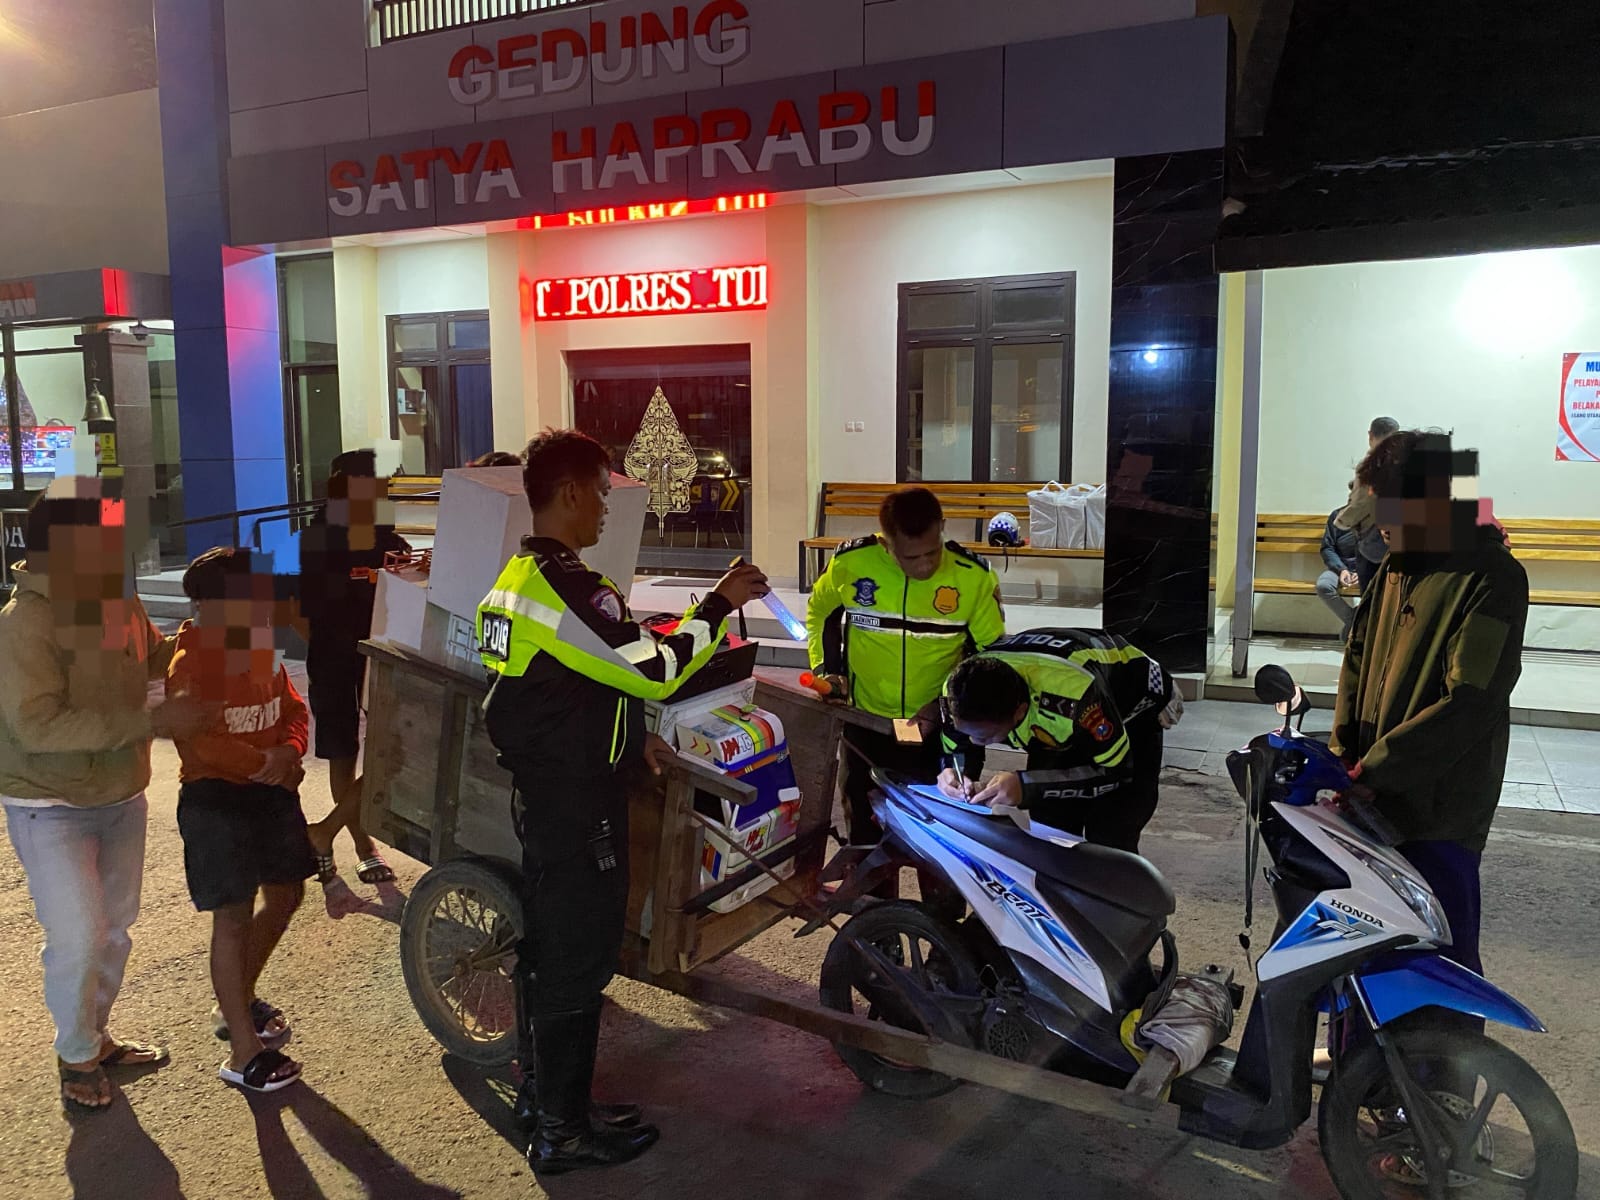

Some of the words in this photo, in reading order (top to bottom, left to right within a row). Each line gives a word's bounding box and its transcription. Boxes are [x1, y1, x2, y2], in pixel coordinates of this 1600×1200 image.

[448, 0, 750, 104] GEDUNG
[328, 138, 521, 217] SATYA
[552, 80, 937, 193] HAPRABU
[568, 270, 690, 315] POLRES
[1574, 379, 1600, 387] PELAYA
[1042, 781, 1120, 800] POLISI
[1330, 898, 1385, 928] HONDA
